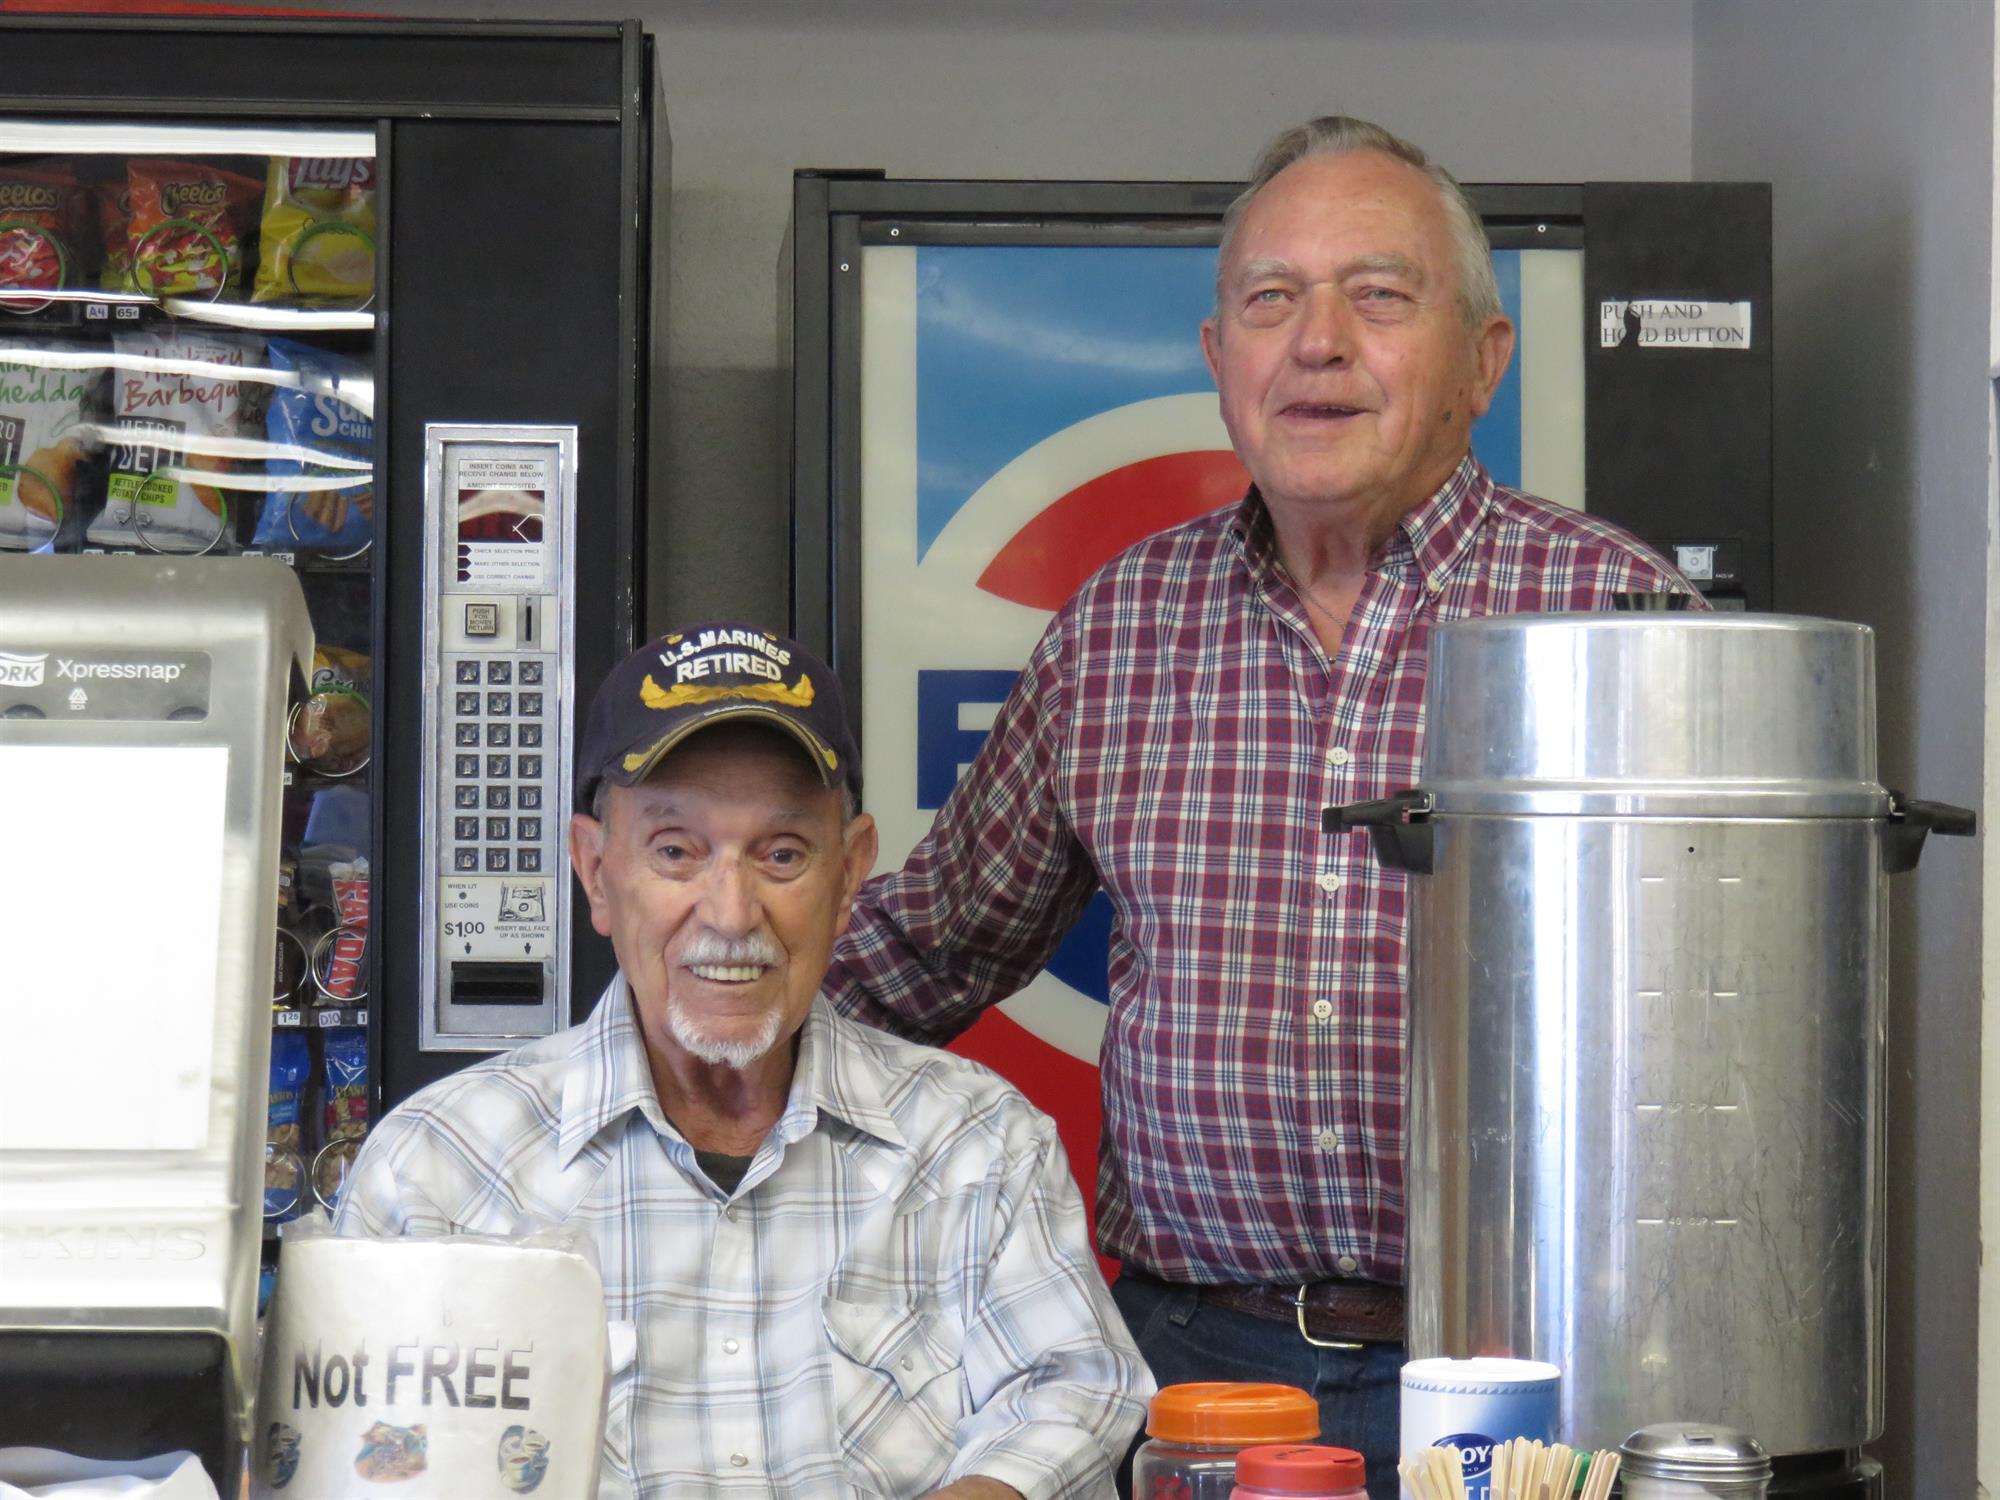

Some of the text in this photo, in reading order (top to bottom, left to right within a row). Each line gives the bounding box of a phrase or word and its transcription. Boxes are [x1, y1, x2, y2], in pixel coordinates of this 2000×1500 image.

[0, 185, 57, 207] eetos
[89, 306, 106, 318] A4
[1660, 304, 1702, 319] AND
[1664, 327, 1744, 342] BUTTON
[0, 371, 88, 404] hedda
[124, 378, 241, 413] Barbequ
[699, 629, 792, 667] MARINES
[676, 652, 782, 683] RETIRED
[444, 921, 485, 938] $1.00
[293, 1337, 533, 1411] Not FREE
